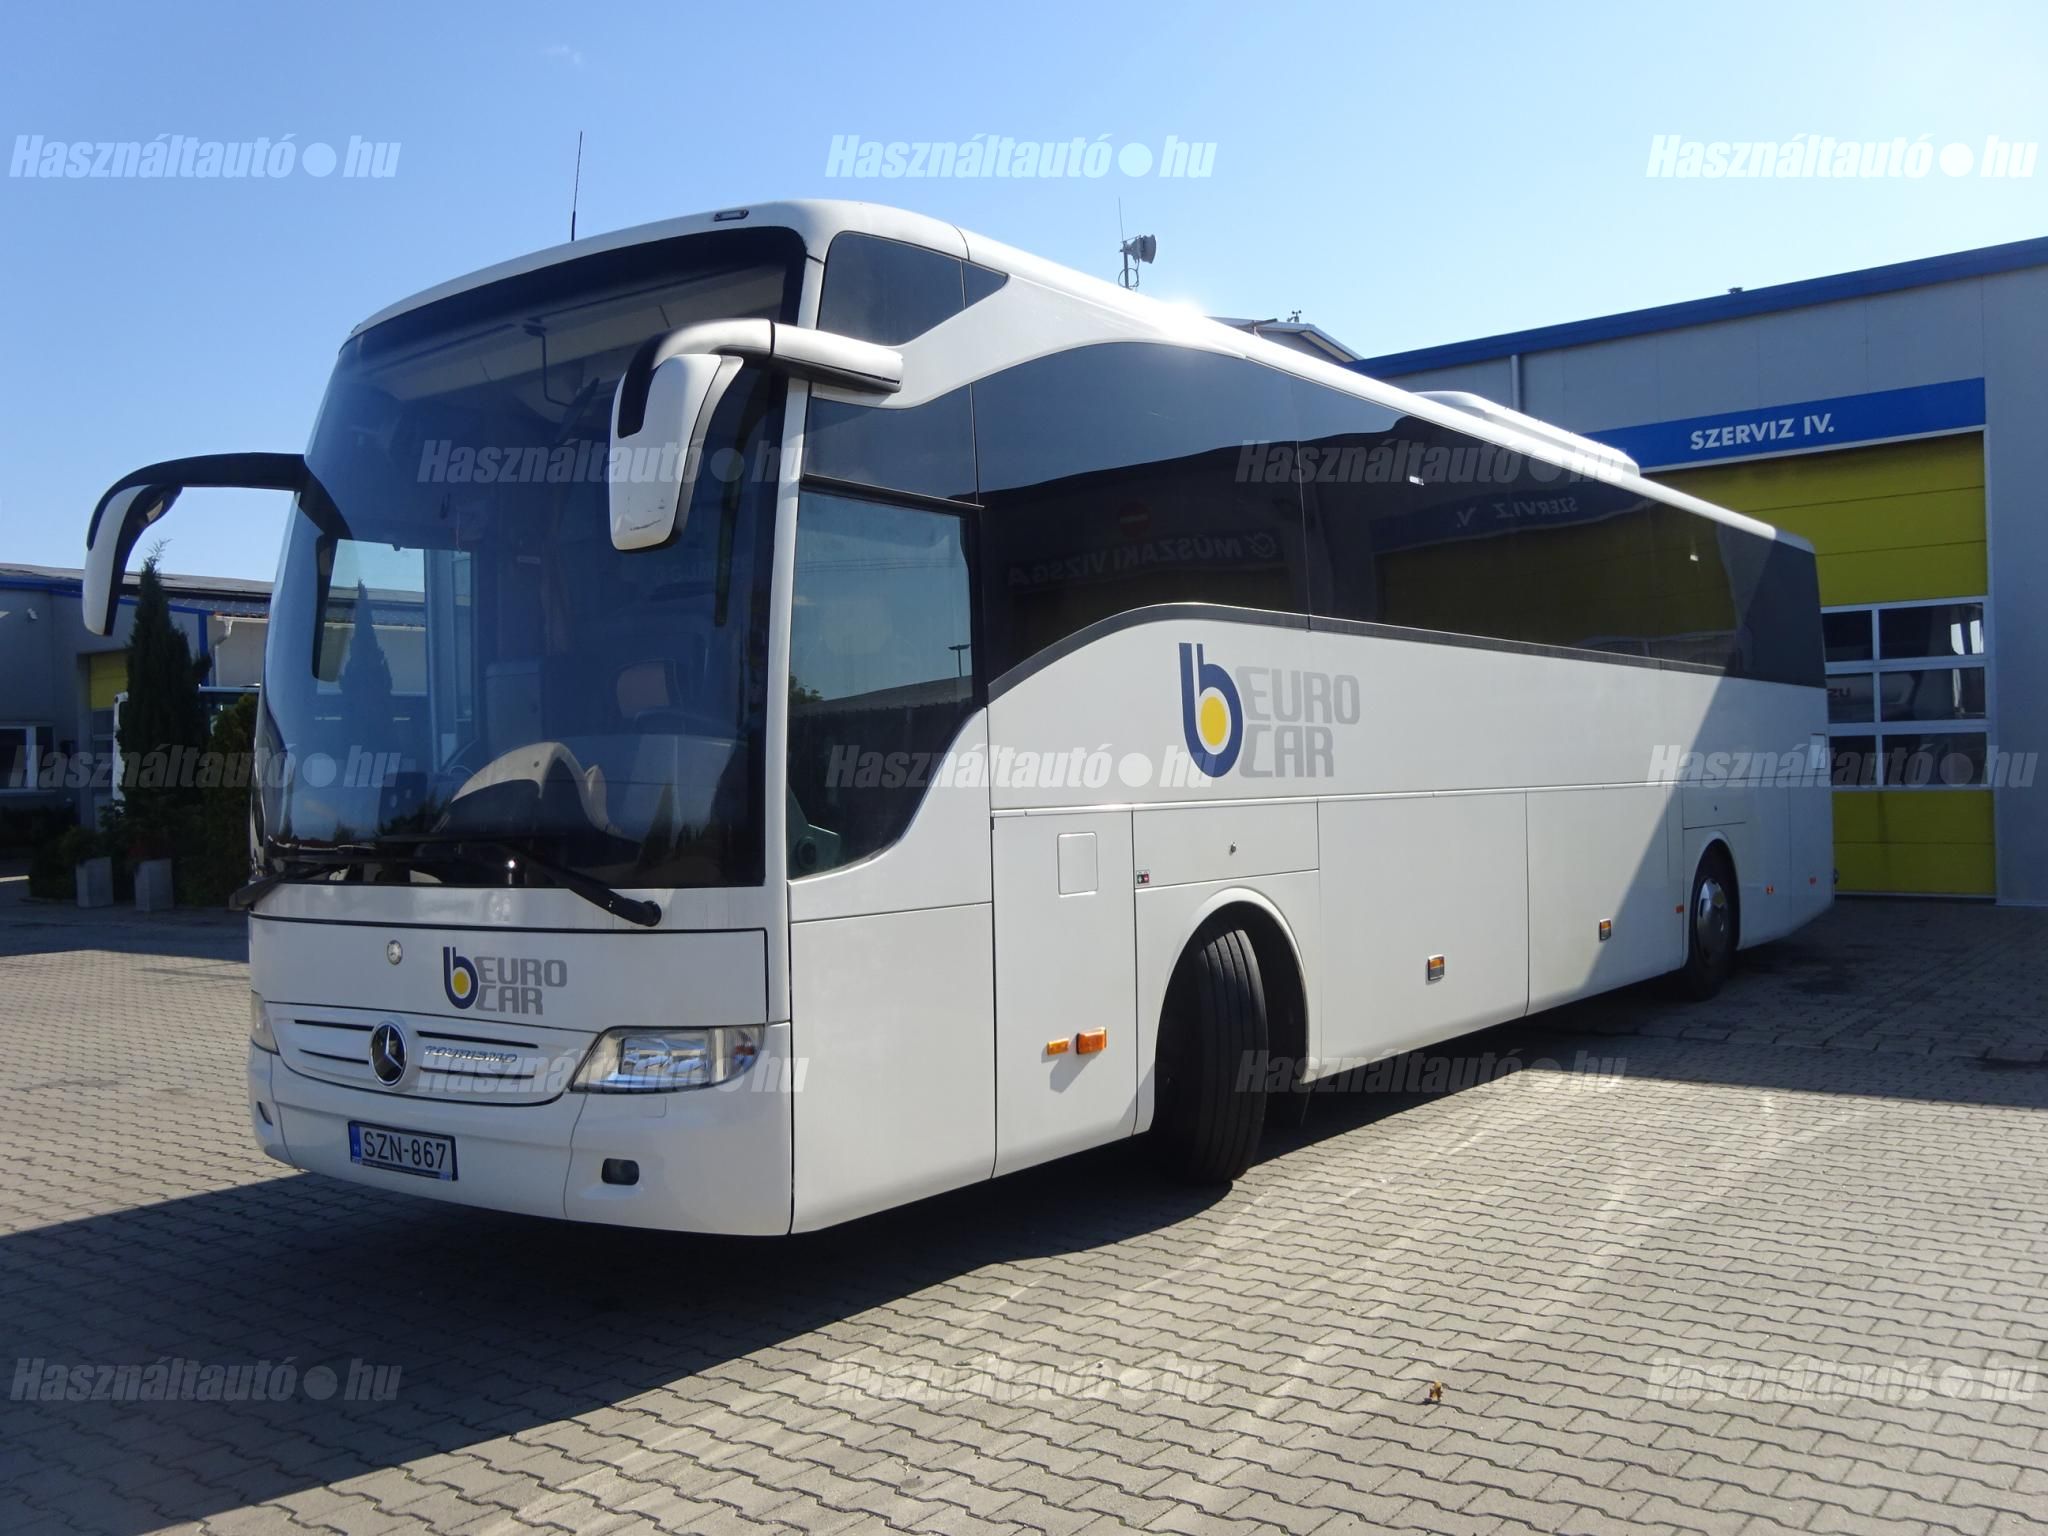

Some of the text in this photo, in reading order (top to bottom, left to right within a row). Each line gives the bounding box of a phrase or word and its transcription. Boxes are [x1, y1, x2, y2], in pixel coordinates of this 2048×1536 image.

[1690, 413, 1835, 450] SZERVIZ IV.
[1235, 666, 1361, 725] EURO
[1239, 724, 1335, 778] CAR
[474, 956, 568, 988] EURO
[475, 984, 544, 1016] CAR
[364, 1131, 446, 1169] SZN-867
